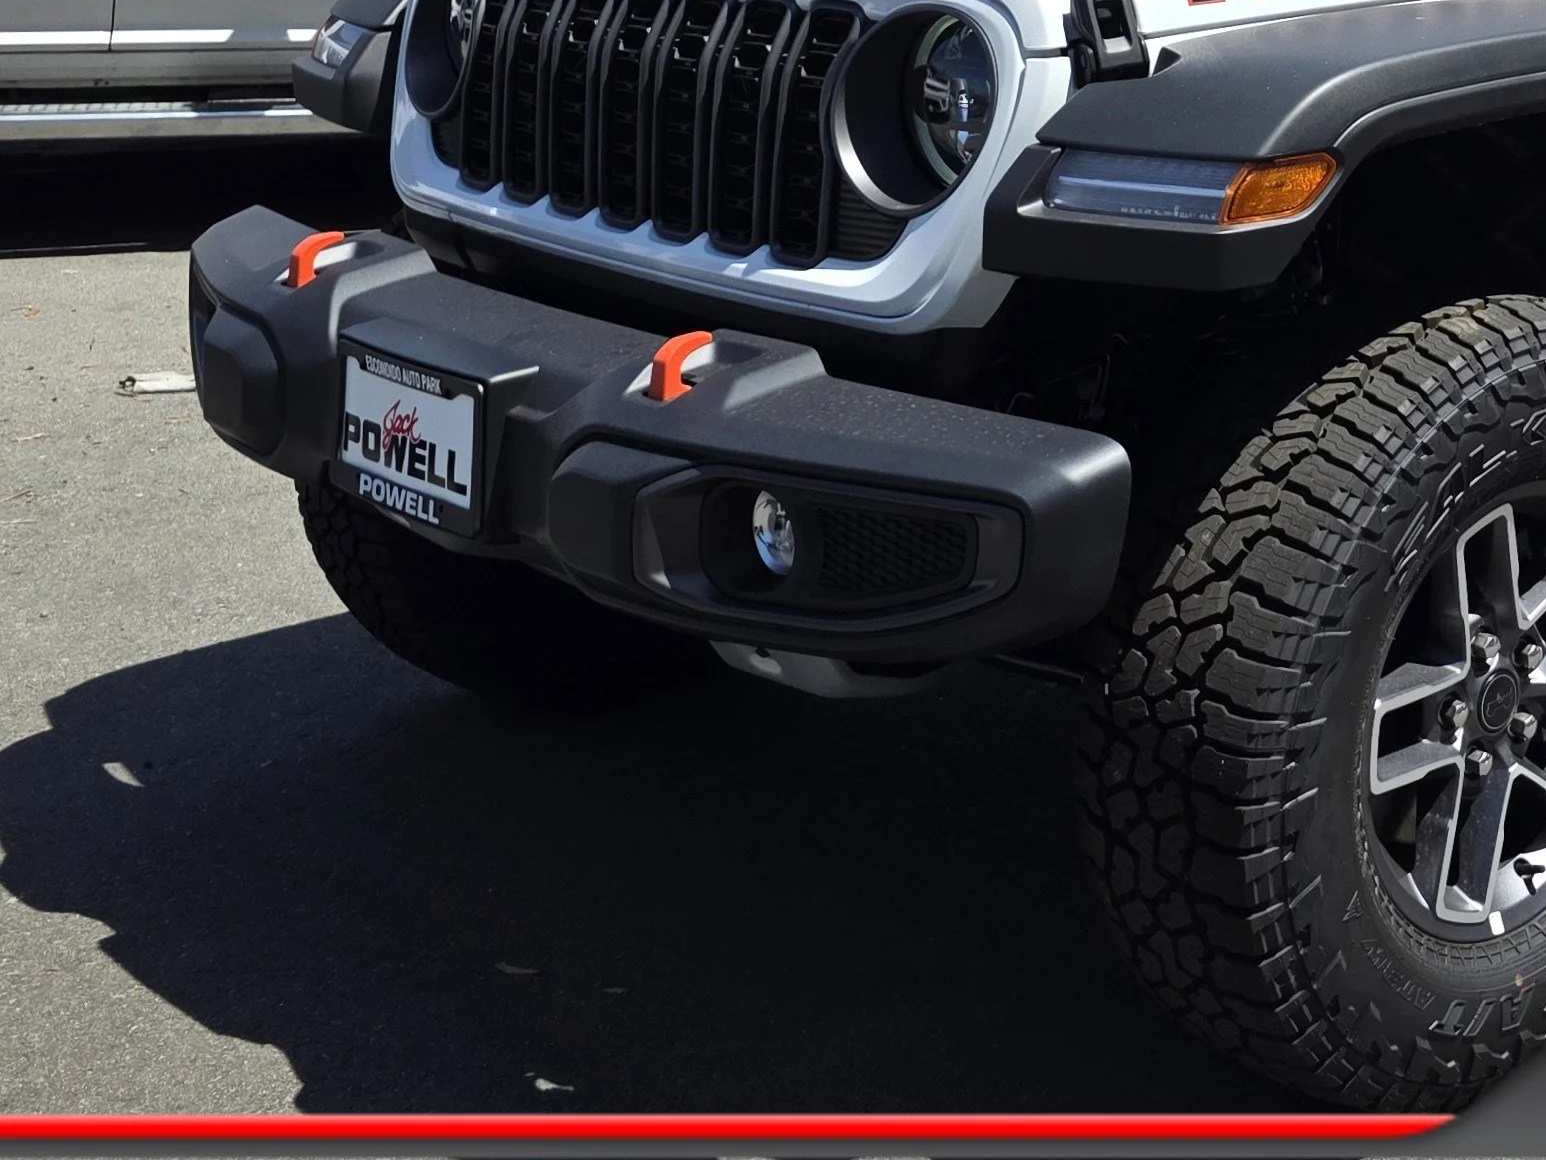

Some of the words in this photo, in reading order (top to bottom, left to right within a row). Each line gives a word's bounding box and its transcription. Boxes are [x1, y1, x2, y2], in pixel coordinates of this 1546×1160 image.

[365, 354, 402, 381] ESCONDIDO
[402, 367, 422, 389] AUTO
[421, 373, 442, 395] PARK
[383, 399, 422, 452] Jack
[343, 411, 468, 497] POWELL
[359, 472, 440, 525] POWELL
